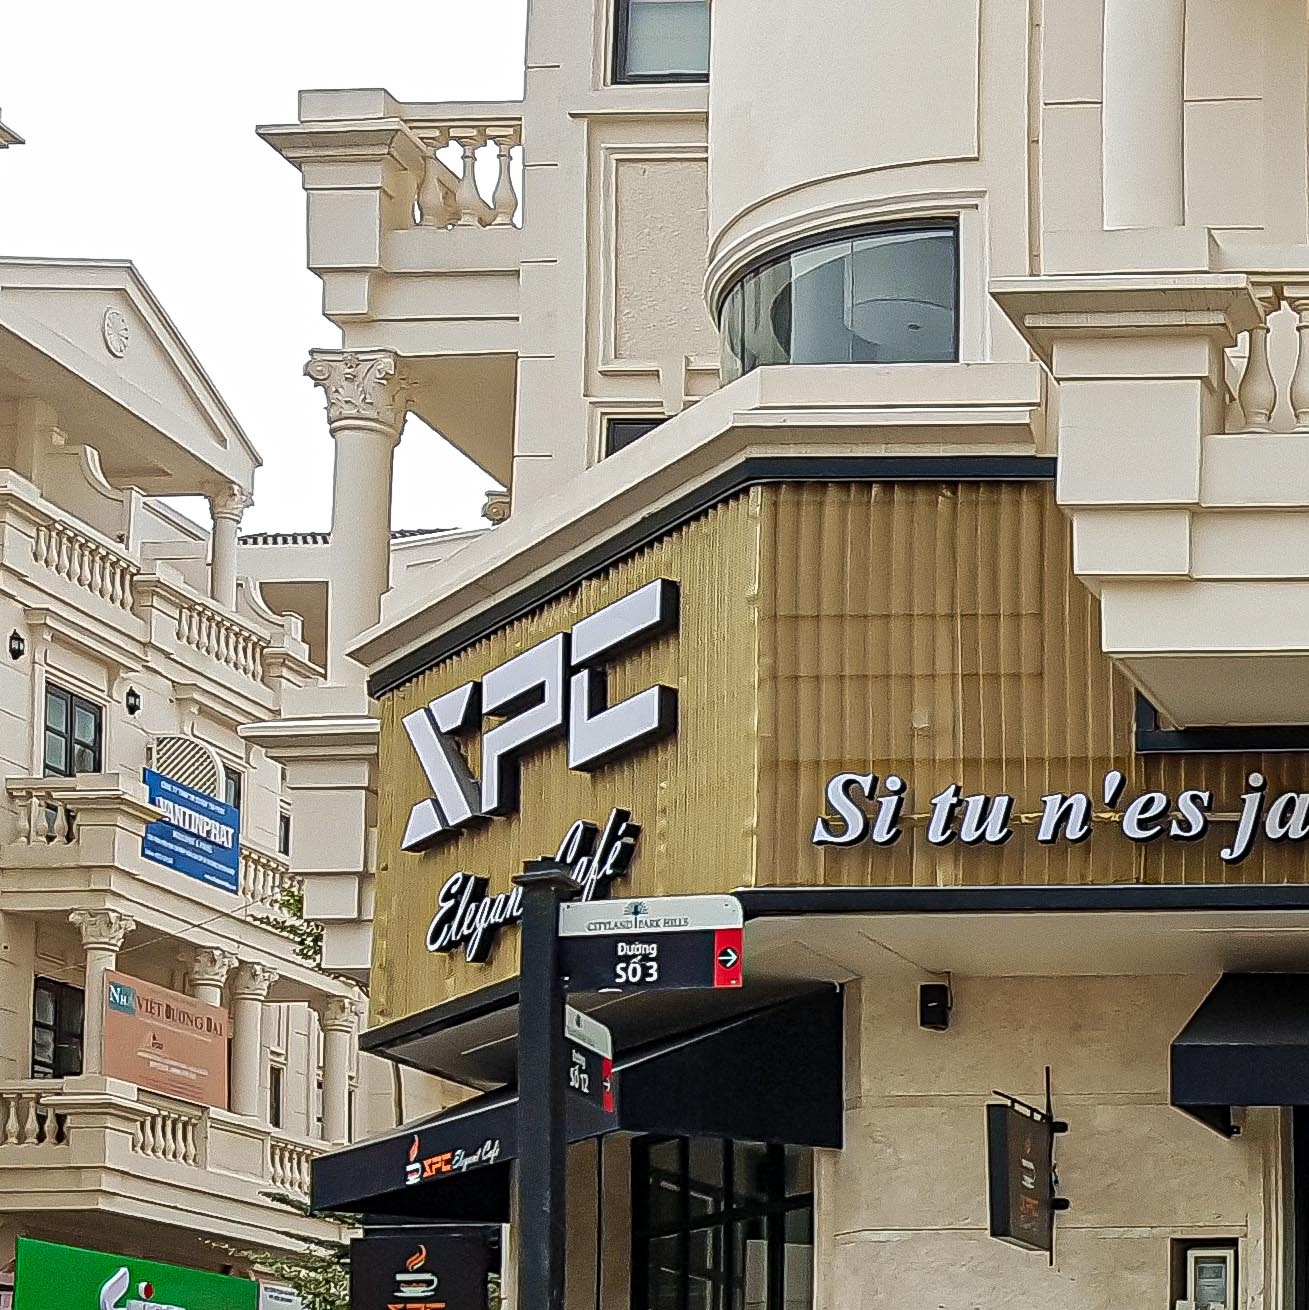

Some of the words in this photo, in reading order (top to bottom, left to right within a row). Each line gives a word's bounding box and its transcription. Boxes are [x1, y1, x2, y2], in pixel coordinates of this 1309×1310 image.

[812, 772, 903, 845] Si
[927, 783, 1012, 845] tu
[1038, 769, 1211, 843] n'es
[426, 871, 524, 964] Elegan
[617, 941, 658, 957] Đường
[645, 961, 659, 982] 3
